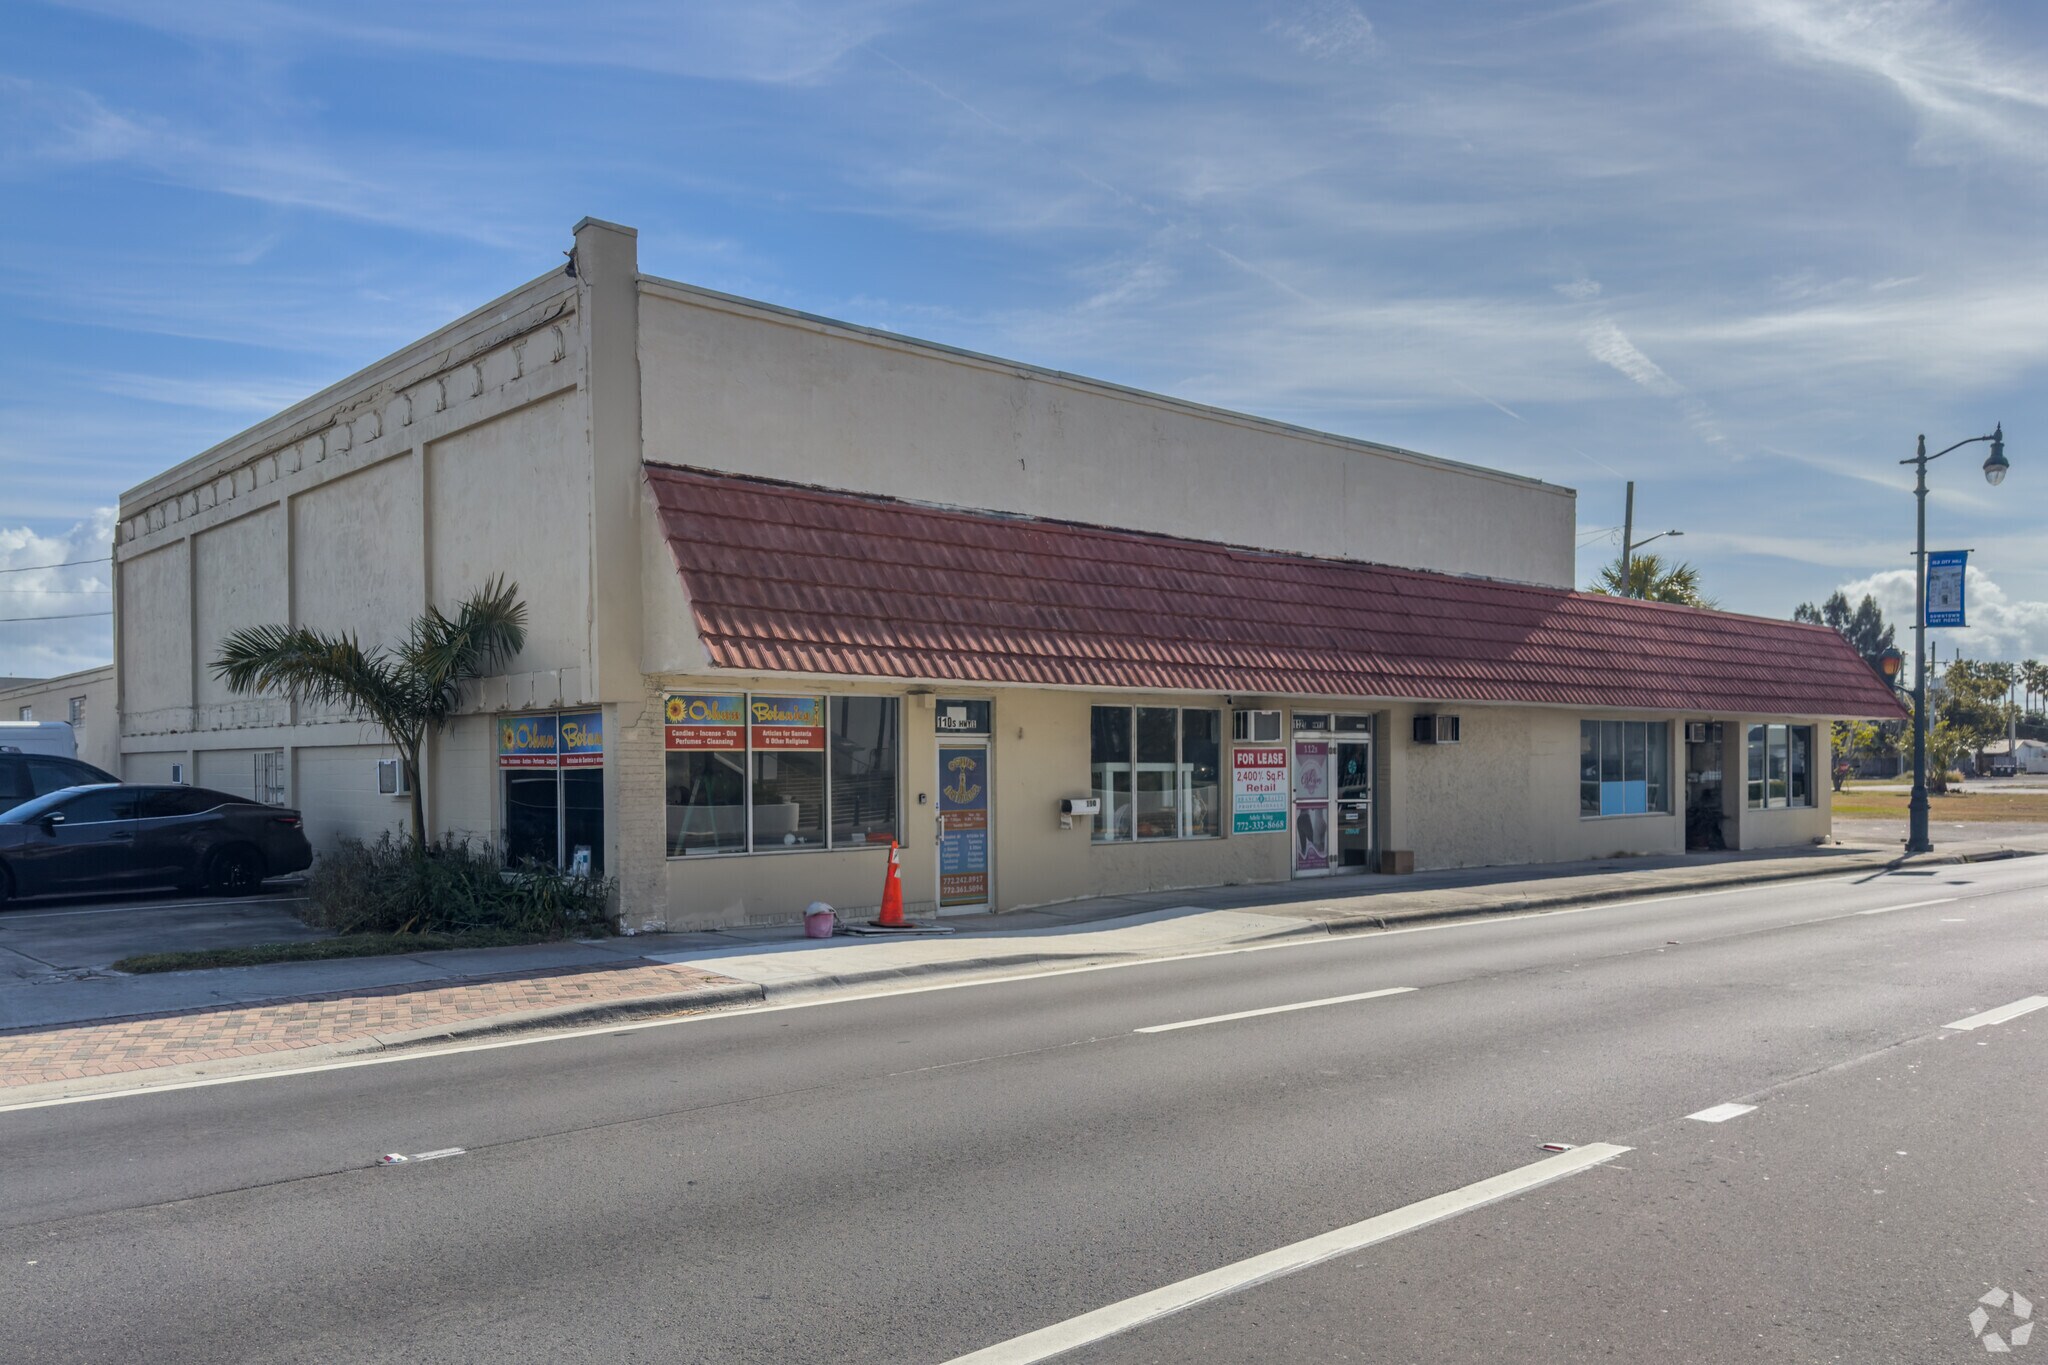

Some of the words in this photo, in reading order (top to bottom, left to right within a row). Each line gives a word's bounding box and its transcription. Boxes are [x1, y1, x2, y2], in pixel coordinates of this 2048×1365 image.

[689, 700, 741, 720] Oshun
[752, 702, 810, 723] Botanica
[516, 722, 556, 748] Oshun
[706, 738, 734, 746] Cleansing
[785, 738, 809, 746] Religions
[1237, 753, 1254, 764] FOR
[1257, 752, 1284, 764] LEASE
[1246, 784, 1276, 792] Retail
[1236, 820, 1285, 831] 772-332-8668
